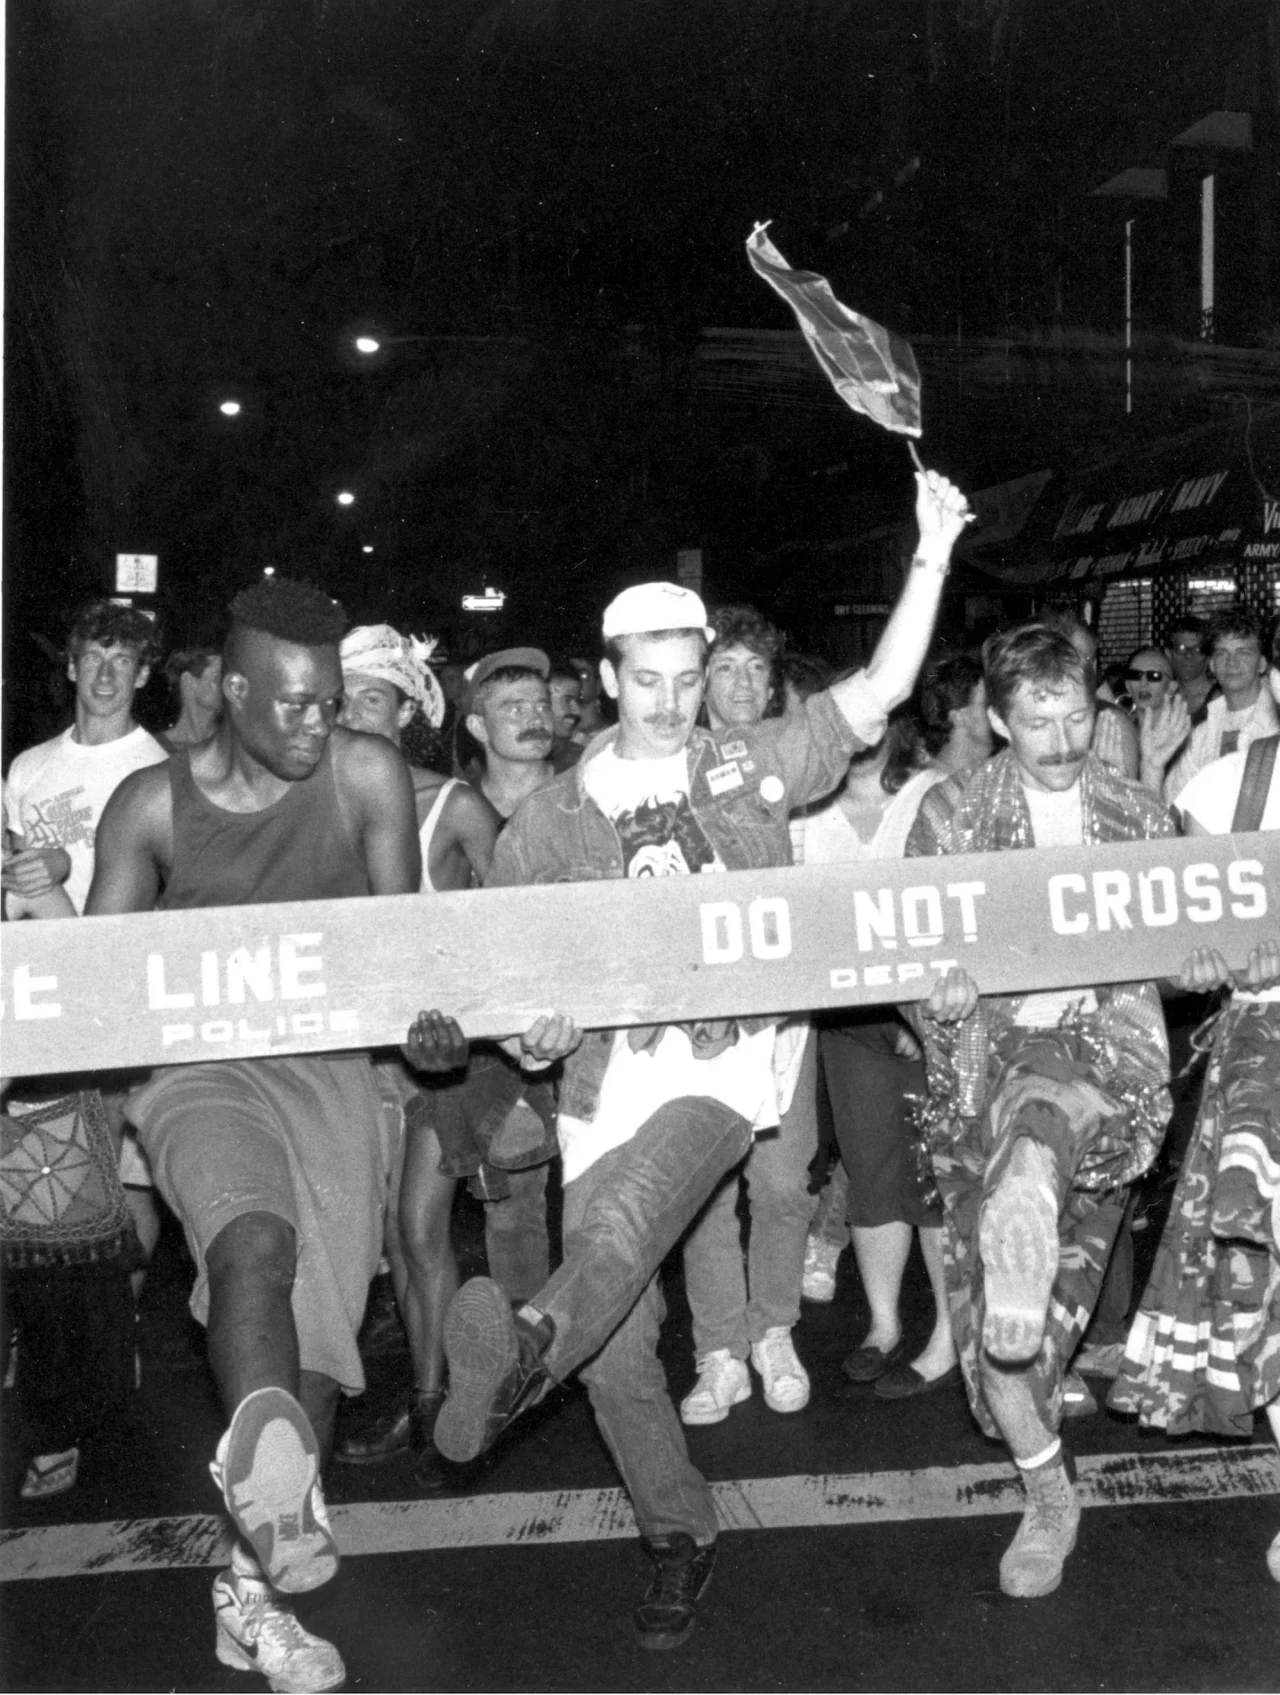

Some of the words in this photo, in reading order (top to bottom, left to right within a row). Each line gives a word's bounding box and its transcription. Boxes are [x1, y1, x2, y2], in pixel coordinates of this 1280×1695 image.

[148, 932, 326, 1010] LINE
[700, 895, 792, 964] DO
[853, 881, 986, 951] NOT
[1048, 859, 1268, 935] CROSS
[162, 1010, 360, 1046] POLICE
